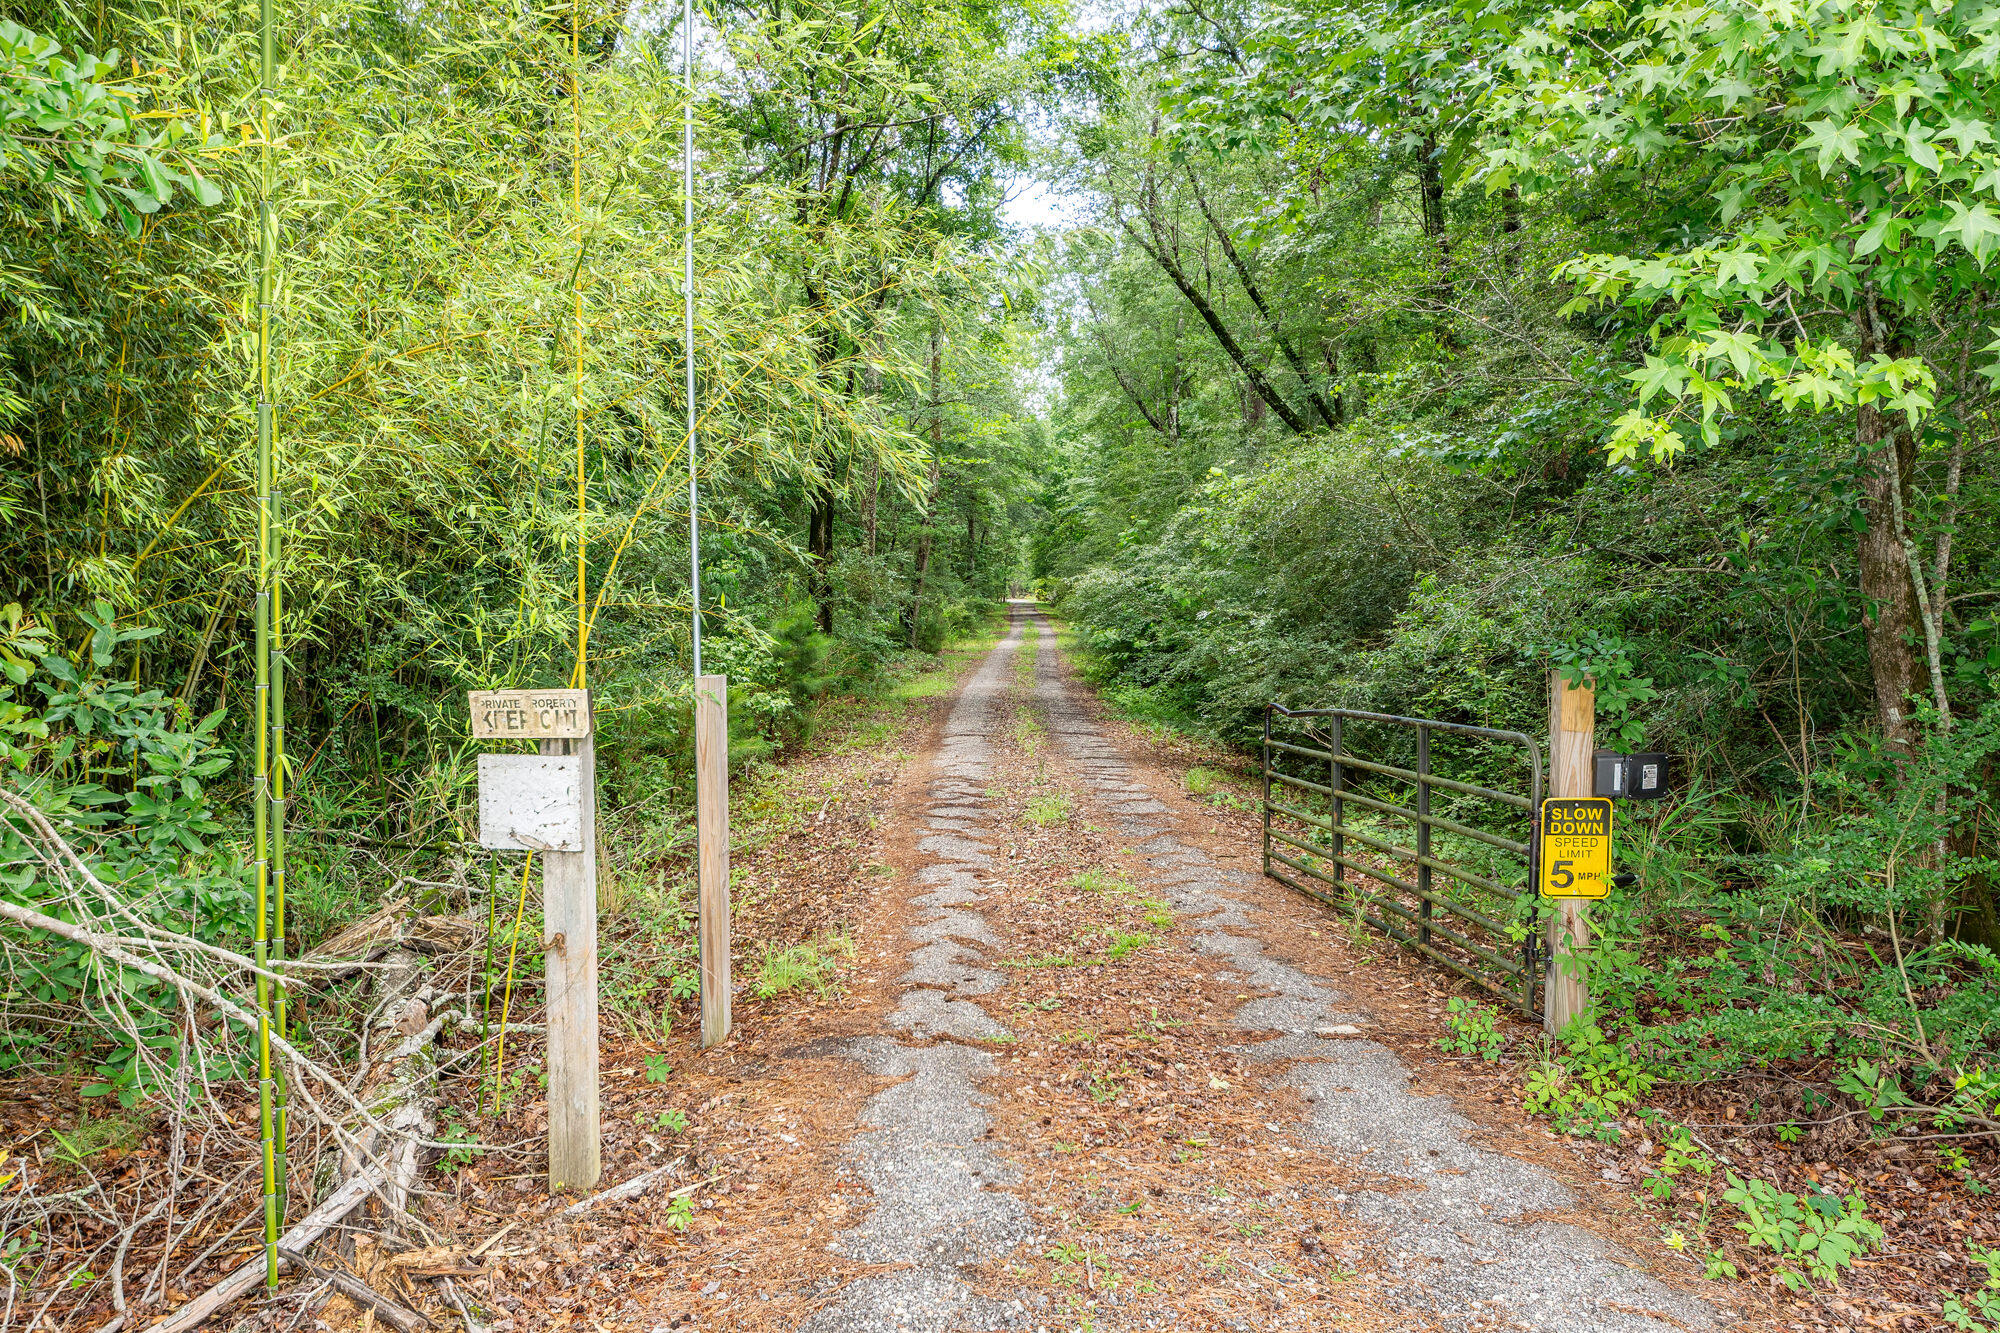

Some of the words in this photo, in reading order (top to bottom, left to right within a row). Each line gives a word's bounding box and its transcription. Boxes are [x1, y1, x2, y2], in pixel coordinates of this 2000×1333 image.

[530, 698, 577, 709] ROPERTY
[1551, 807, 1603, 821] SLOW
[1550, 822, 1604, 835] DOWN
[1554, 837, 1599, 848] SPEED
[1559, 850, 1593, 859] LIMIT
[1550, 860, 1575, 889] 5
[1578, 872, 1601, 881] MPH
